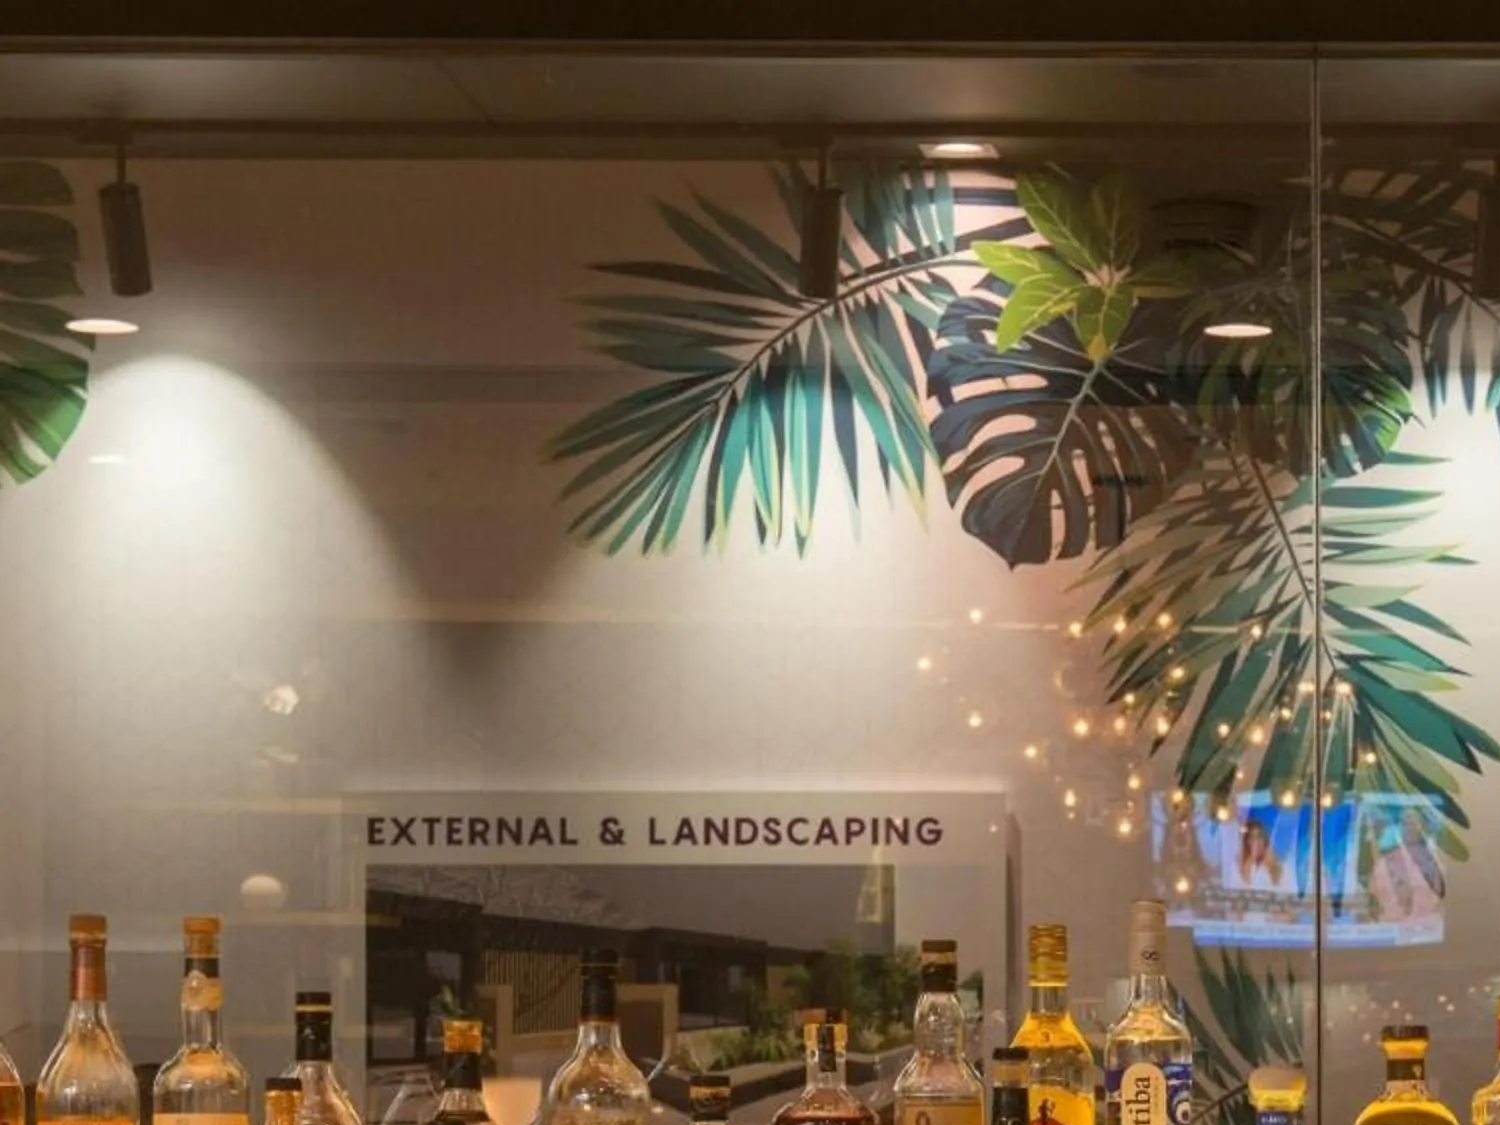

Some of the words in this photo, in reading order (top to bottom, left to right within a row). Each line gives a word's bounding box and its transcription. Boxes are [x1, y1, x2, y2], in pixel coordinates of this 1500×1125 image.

[366, 816, 578, 846] EXTERNAL
[600, 816, 626, 846] &
[648, 816, 944, 846] LANDSCAPING
